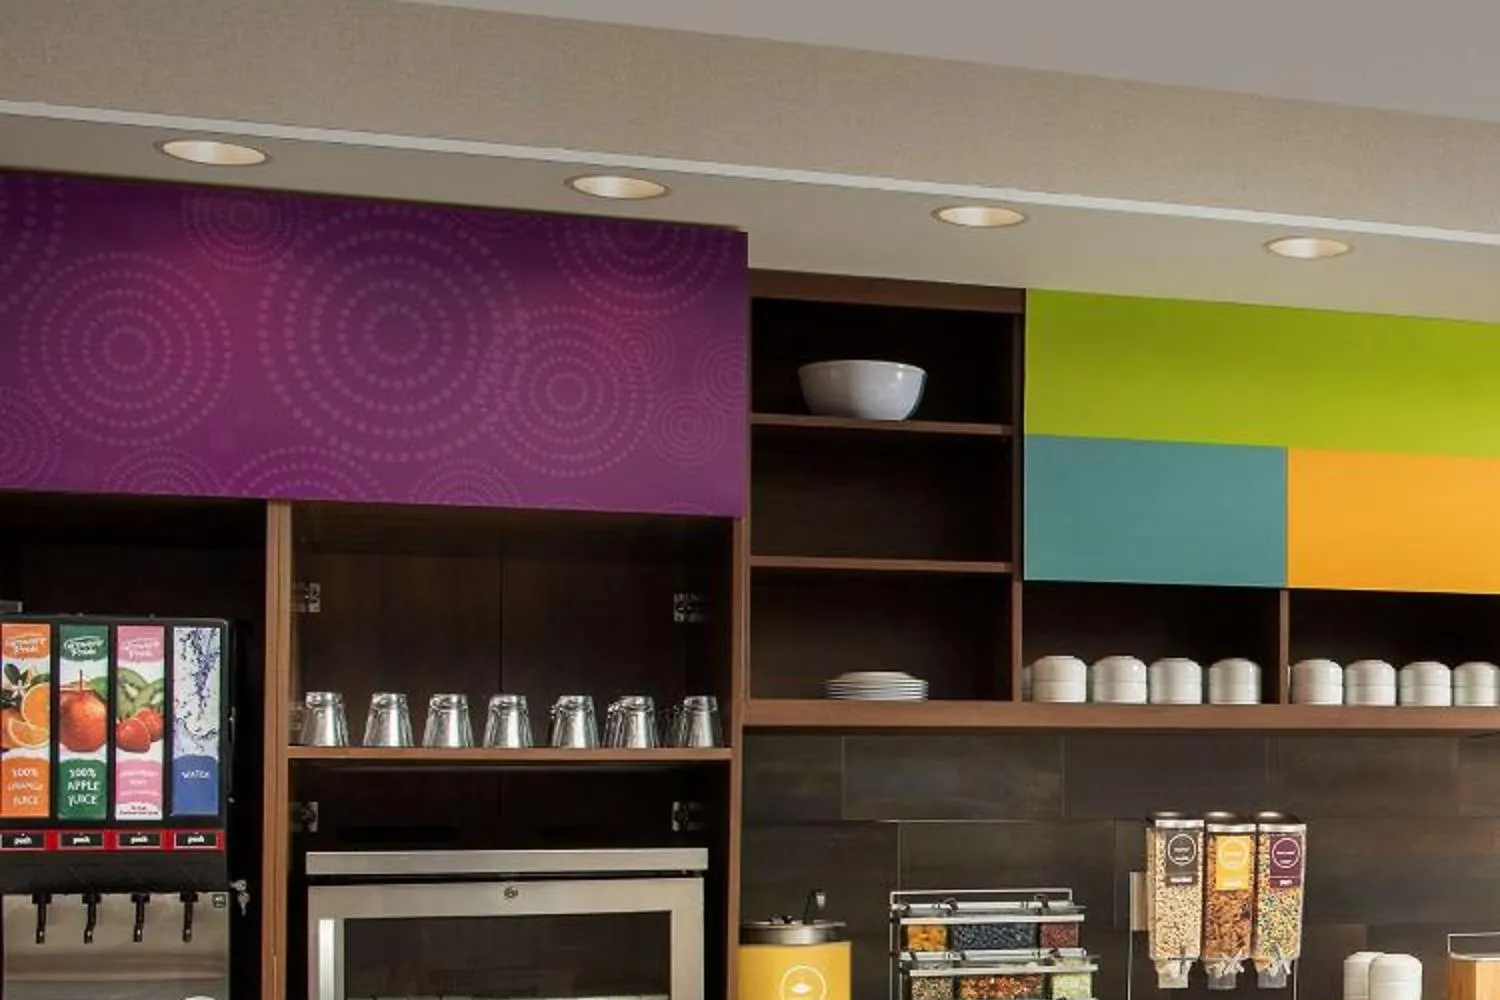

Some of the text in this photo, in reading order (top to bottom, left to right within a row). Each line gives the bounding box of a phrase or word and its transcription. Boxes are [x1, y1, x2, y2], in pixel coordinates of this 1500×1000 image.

[69, 767, 97, 778] 100%
[67, 780, 100, 791] APPLE
[67, 794, 97, 807] JUICE
